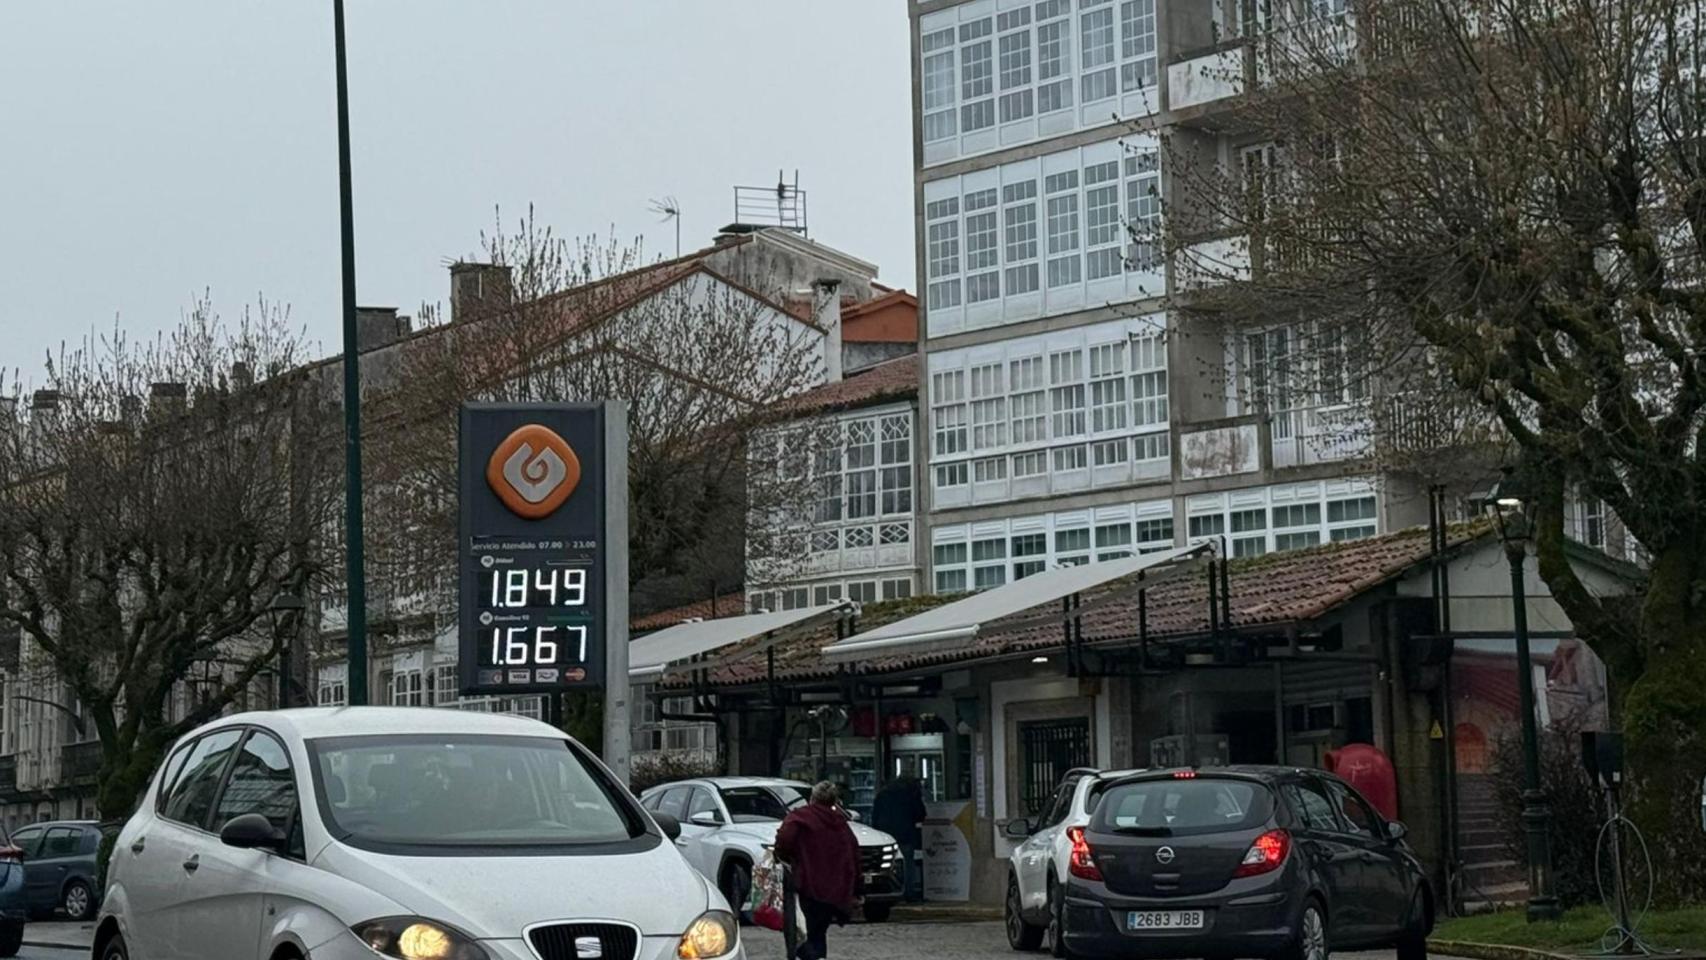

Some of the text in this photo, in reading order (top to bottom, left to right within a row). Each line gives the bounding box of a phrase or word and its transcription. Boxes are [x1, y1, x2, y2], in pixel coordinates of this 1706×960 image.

[502, 541, 536, 550] Atendido
[492, 569, 586, 608] 1.849
[492, 625, 587, 665] 1.667
[1137, 911, 1201, 926] 2683 JBB
